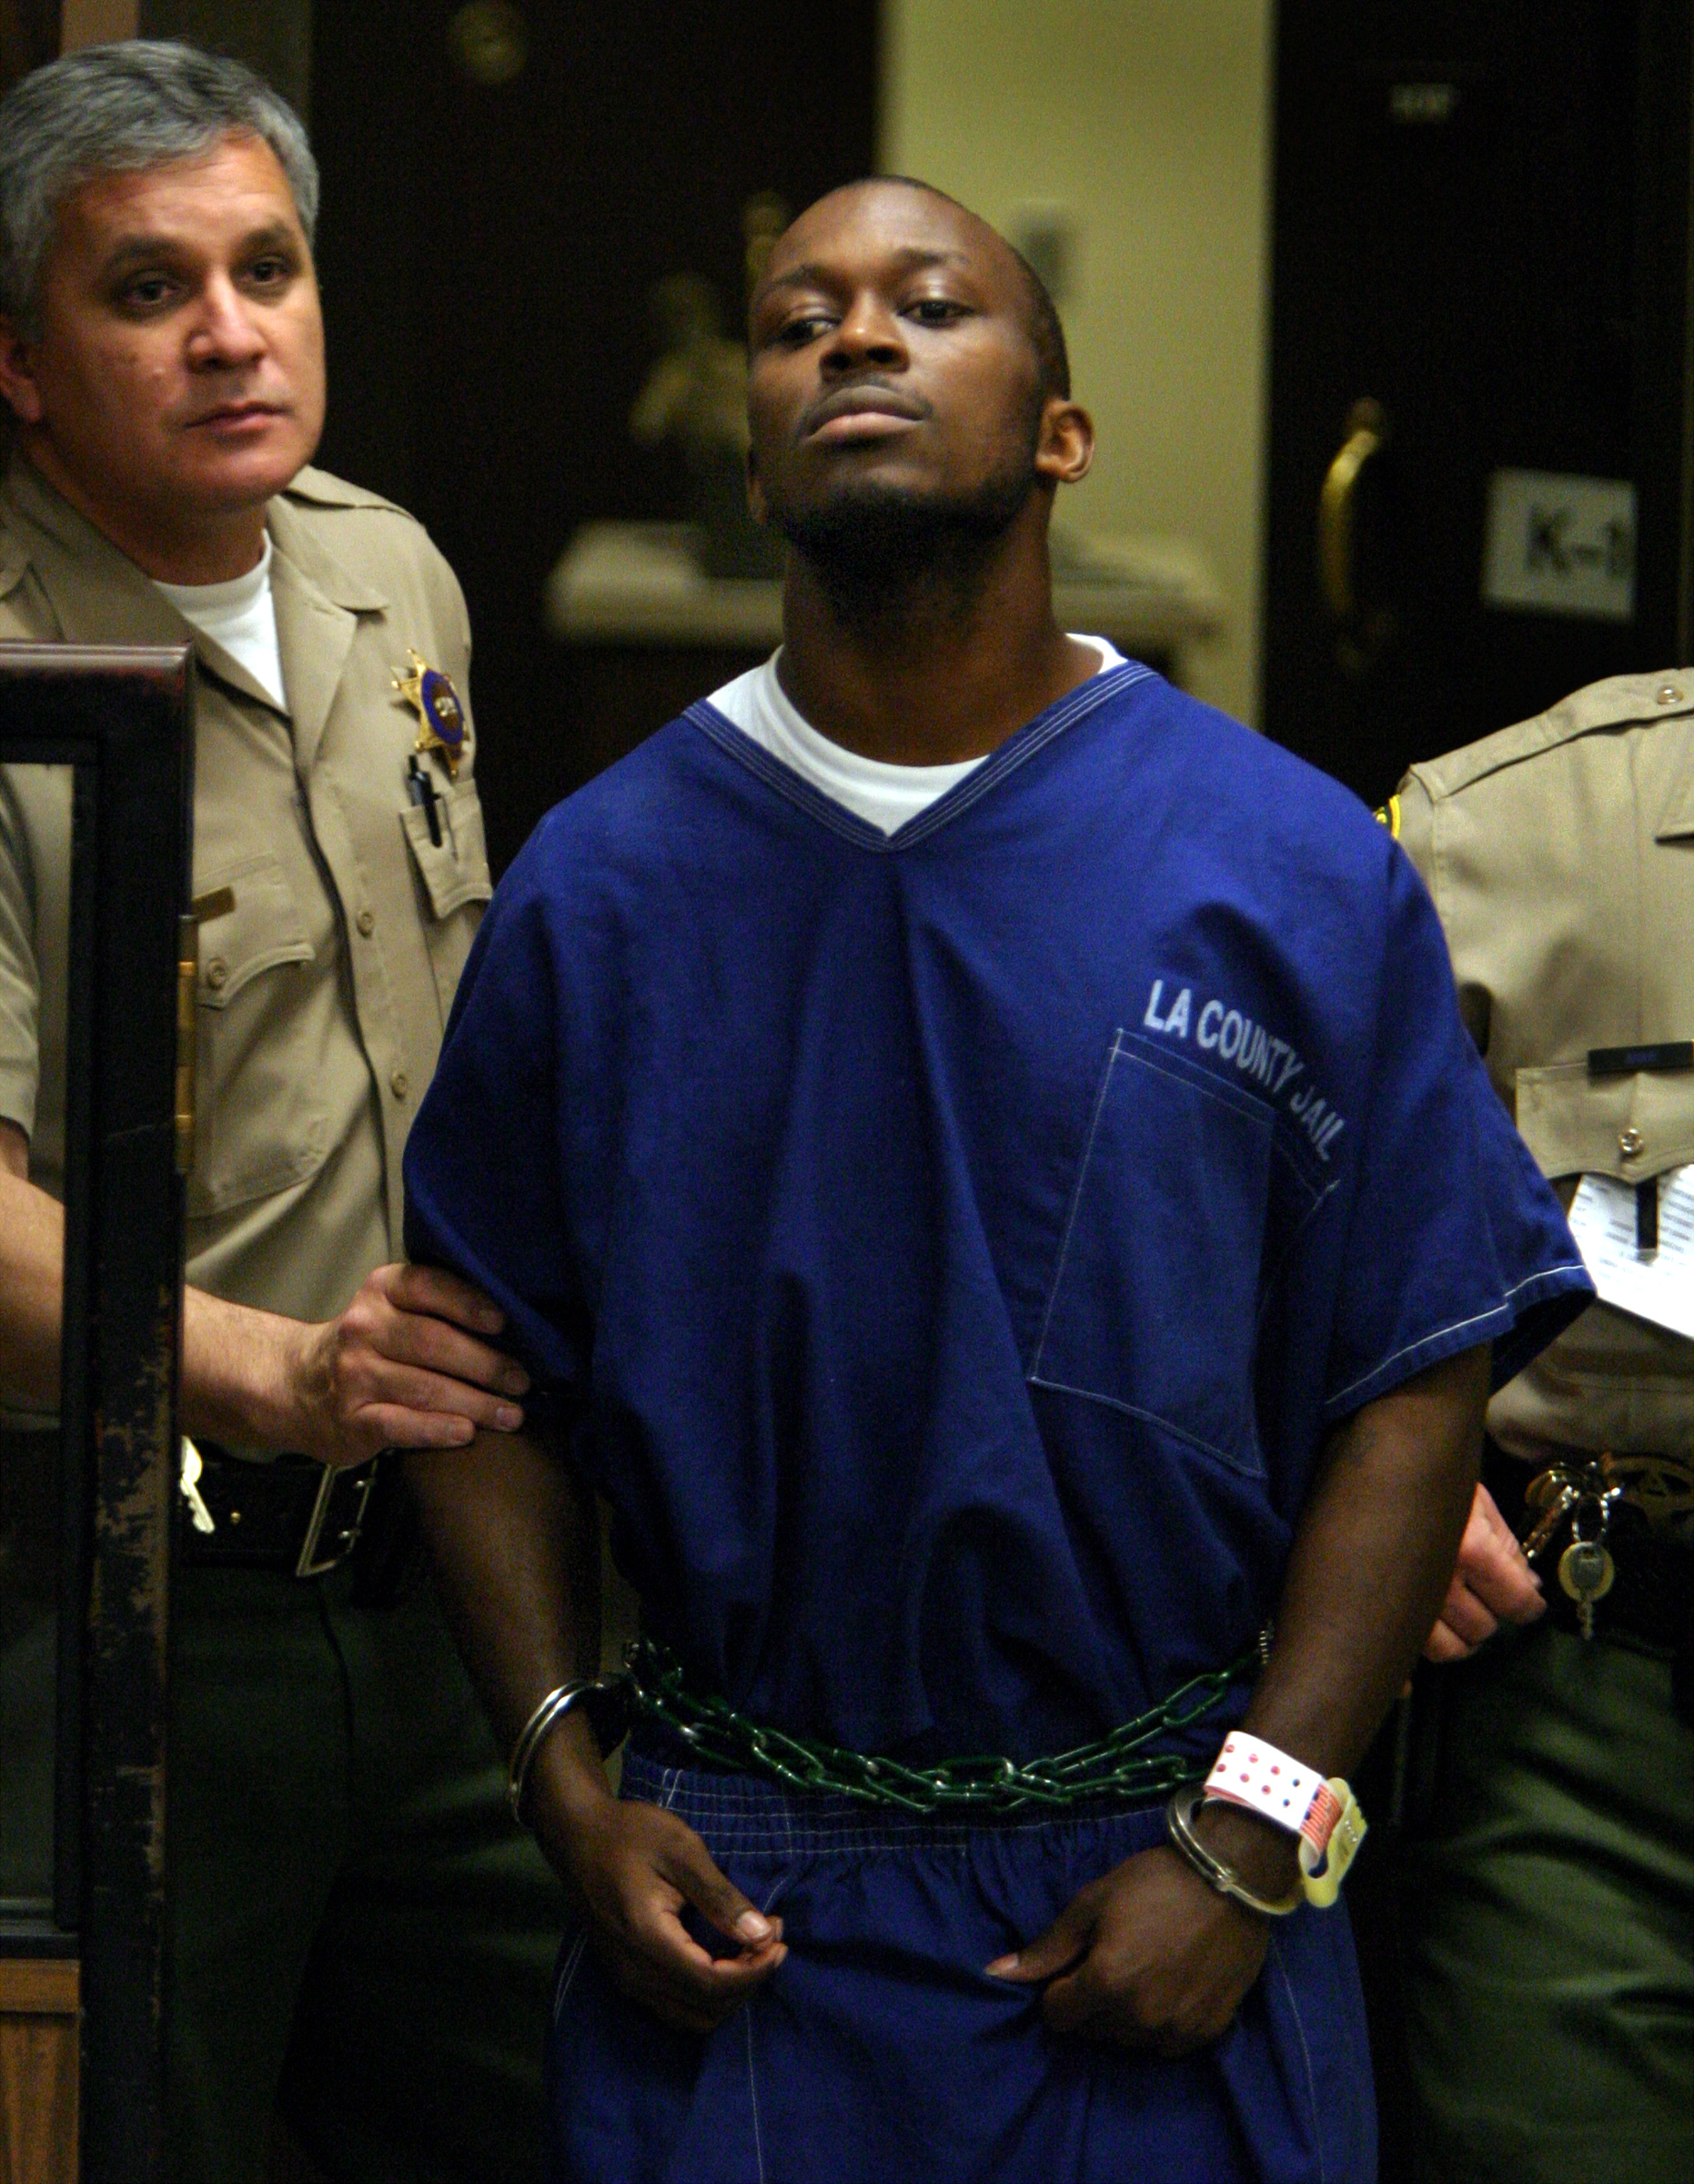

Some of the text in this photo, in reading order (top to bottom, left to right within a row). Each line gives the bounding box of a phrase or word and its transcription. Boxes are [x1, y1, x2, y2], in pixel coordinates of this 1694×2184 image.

[1144, 979, 1345, 1161] LA COUNTY JAIL
